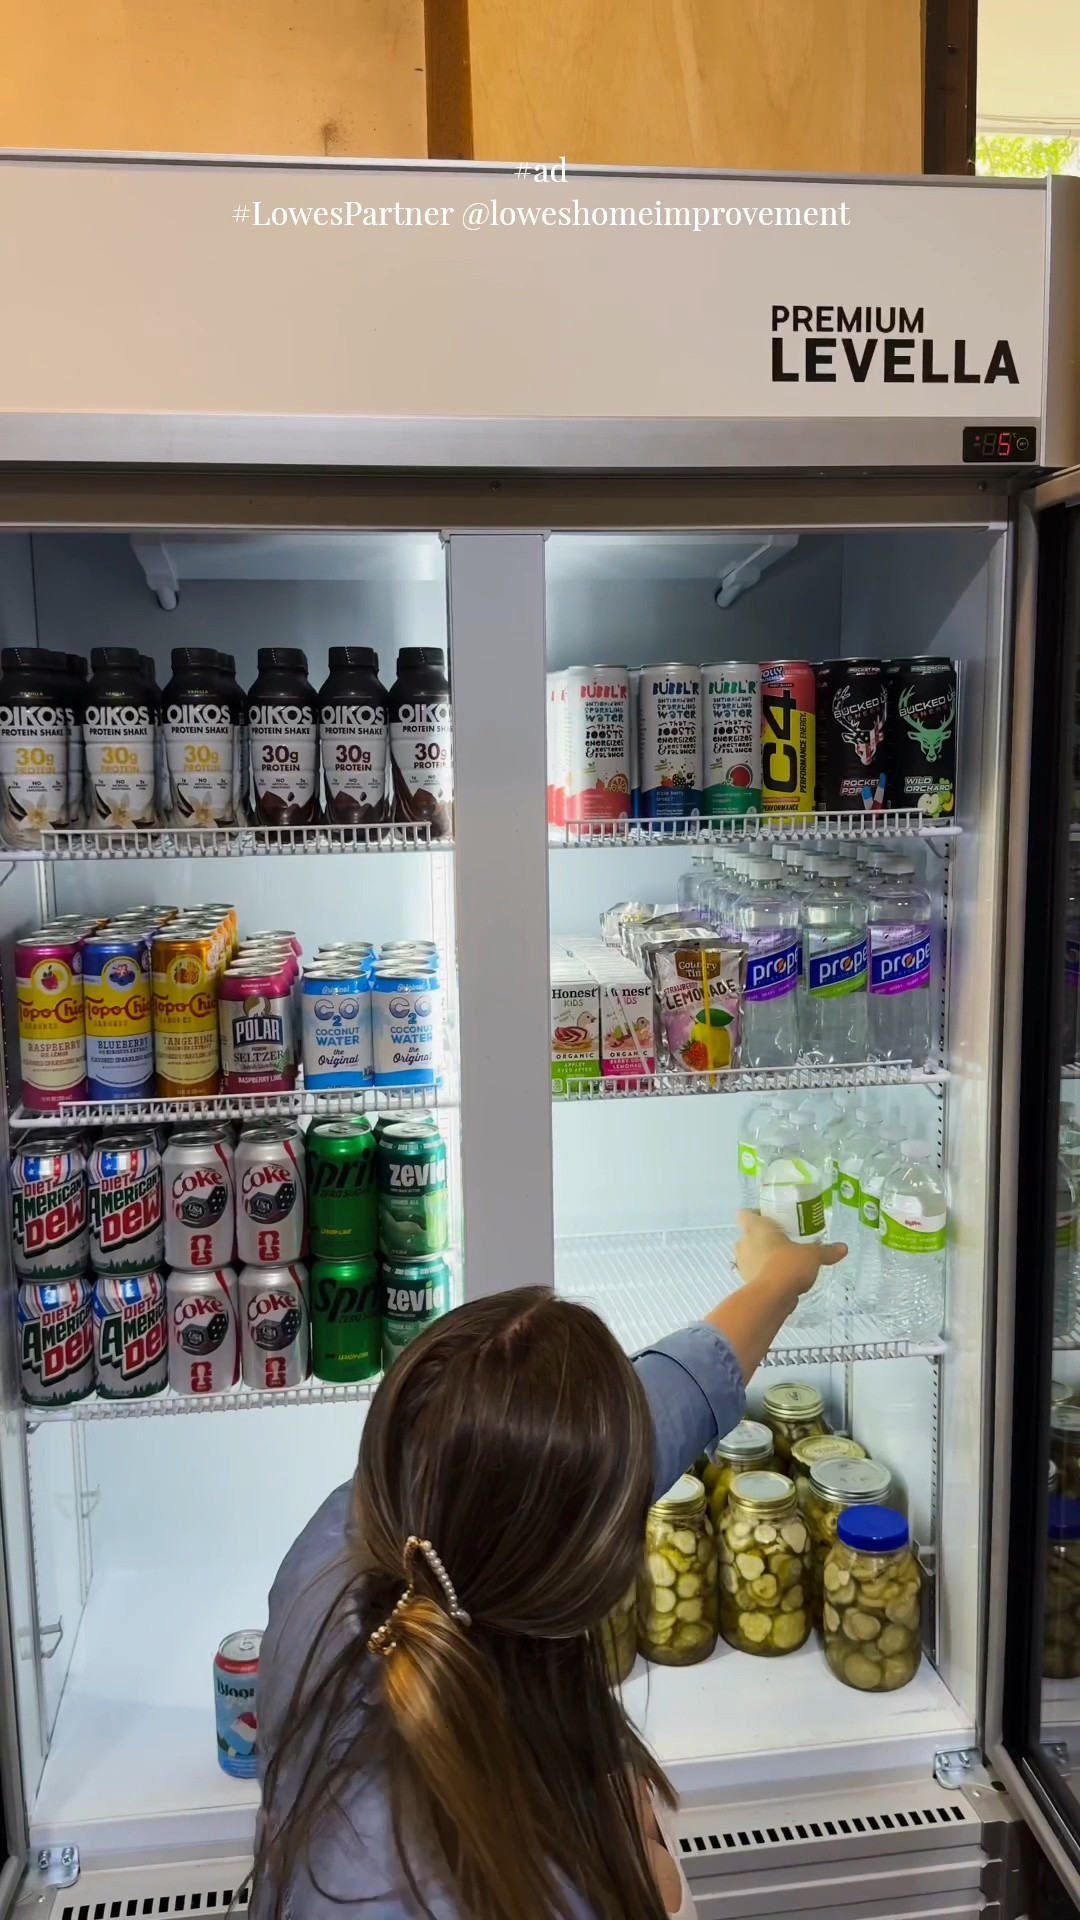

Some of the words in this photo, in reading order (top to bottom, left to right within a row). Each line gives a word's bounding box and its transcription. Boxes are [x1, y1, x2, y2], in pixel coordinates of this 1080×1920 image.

[771, 305, 924, 333] PREMIUM
[771, 337, 1020, 384] LEVELLA
[85, 705, 150, 725] OIKOS
[166, 704, 231, 724] OIKOS
[248, 705, 313, 725] OIKOS
[321, 705, 385, 725] OIKOS
[398, 703, 453, 724] OIKO
[833, 697, 880, 719] BUCKED
[899, 695, 945, 717] BUCKED
[1, 728, 38, 737] PROTEIN
[89, 727, 121, 736] PROTEIN
[123, 727, 148, 736] SHAKE
[171, 726, 203, 734] PROTEIN
[205, 726, 229, 734] SHAKE
[251, 727, 282, 735] PROTEIN
[284, 727, 311, 735] SHAKE
[325, 727, 356, 735] PROTEIN
[358, 727, 383, 735] SHAKE
[402, 725, 435, 733] PROTEIN
[762, 689, 797, 793] C4
[16, 747, 54, 766] 30g
[101, 746, 138, 765] 30g
[183, 745, 219, 764] 30g
[262, 744, 299, 763] 30g
[335, 744, 371, 764] 30g
[261, 763, 301, 771] PROTEIN
[335, 763, 372, 771] PROTEIN
[799, 740, 807, 793] PERFORMANCE
[904, 784, 950, 792] ORCHARD
[762, 804, 799, 812] PERFORMANCE
[551, 987, 598, 999] Honest
[17, 998, 55, 1022] Topo
[85, 996, 125, 1020] Topo
[152, 992, 190, 1016] Topo
[563, 999, 584, 1007] KIDS
[162, 1034, 213, 1046] TANGERINE
[235, 1018, 281, 1044] POLAR
[315, 1027, 360, 1036] COCONUT
[28, 1040, 81, 1052] RASPBERRY
[97, 1037, 148, 1049] BLUEBERRY
[315, 1036, 360, 1046] WATER
[233, 1050, 284, 1063] SELTZER
[318, 1054, 360, 1068] Original
[238, 1076, 270, 1084] RASPBERRY
[172, 1170, 224, 1199] Coke
[242, 1166, 292, 1194] Coke
[256, 1199, 271, 1210] USA
[173, 1298, 224, 1325] Coke
[247, 1294, 297, 1321] Coke
